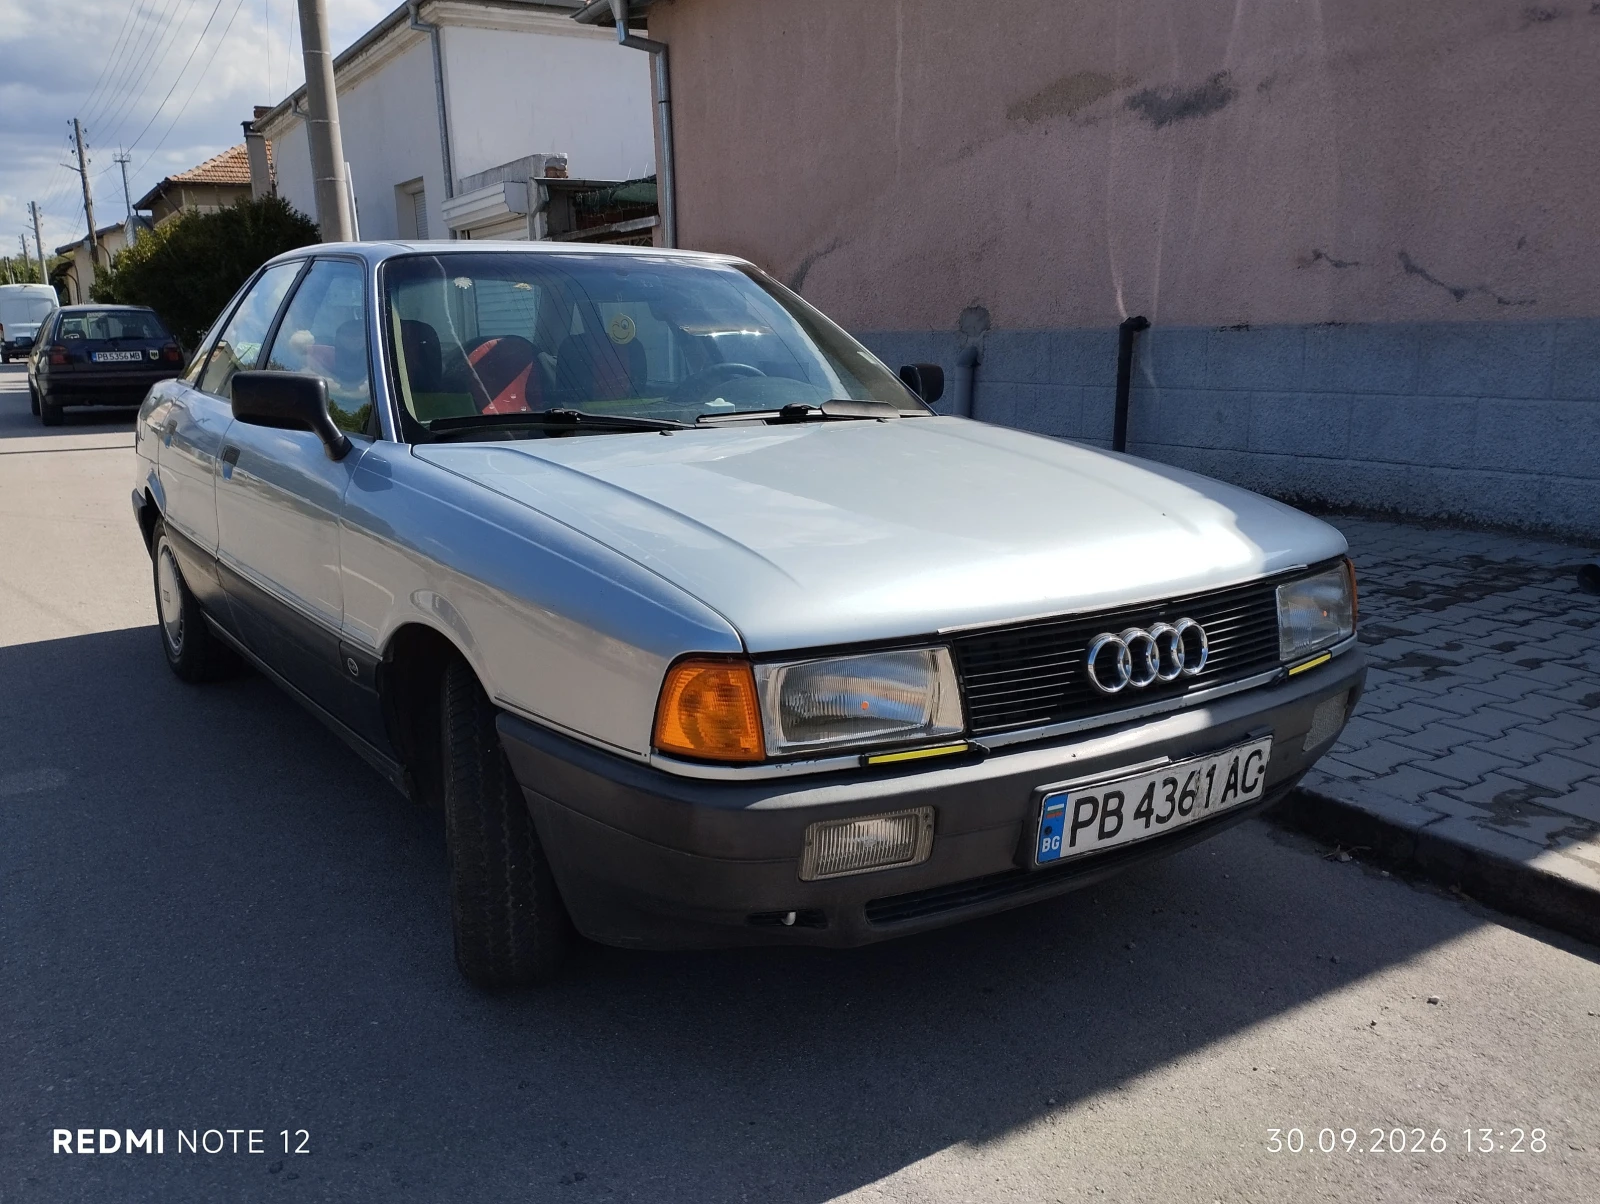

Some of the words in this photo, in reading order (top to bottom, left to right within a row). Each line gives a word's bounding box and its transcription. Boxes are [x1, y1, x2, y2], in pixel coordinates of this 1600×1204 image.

[97, 353, 108, 361] PB
[109, 352, 129, 361] 5356
[1068, 789, 1125, 848] PB
[1133, 763, 1217, 829] 4361
[1220, 748, 1263, 804] AC
[1041, 835, 1061, 853] BG
